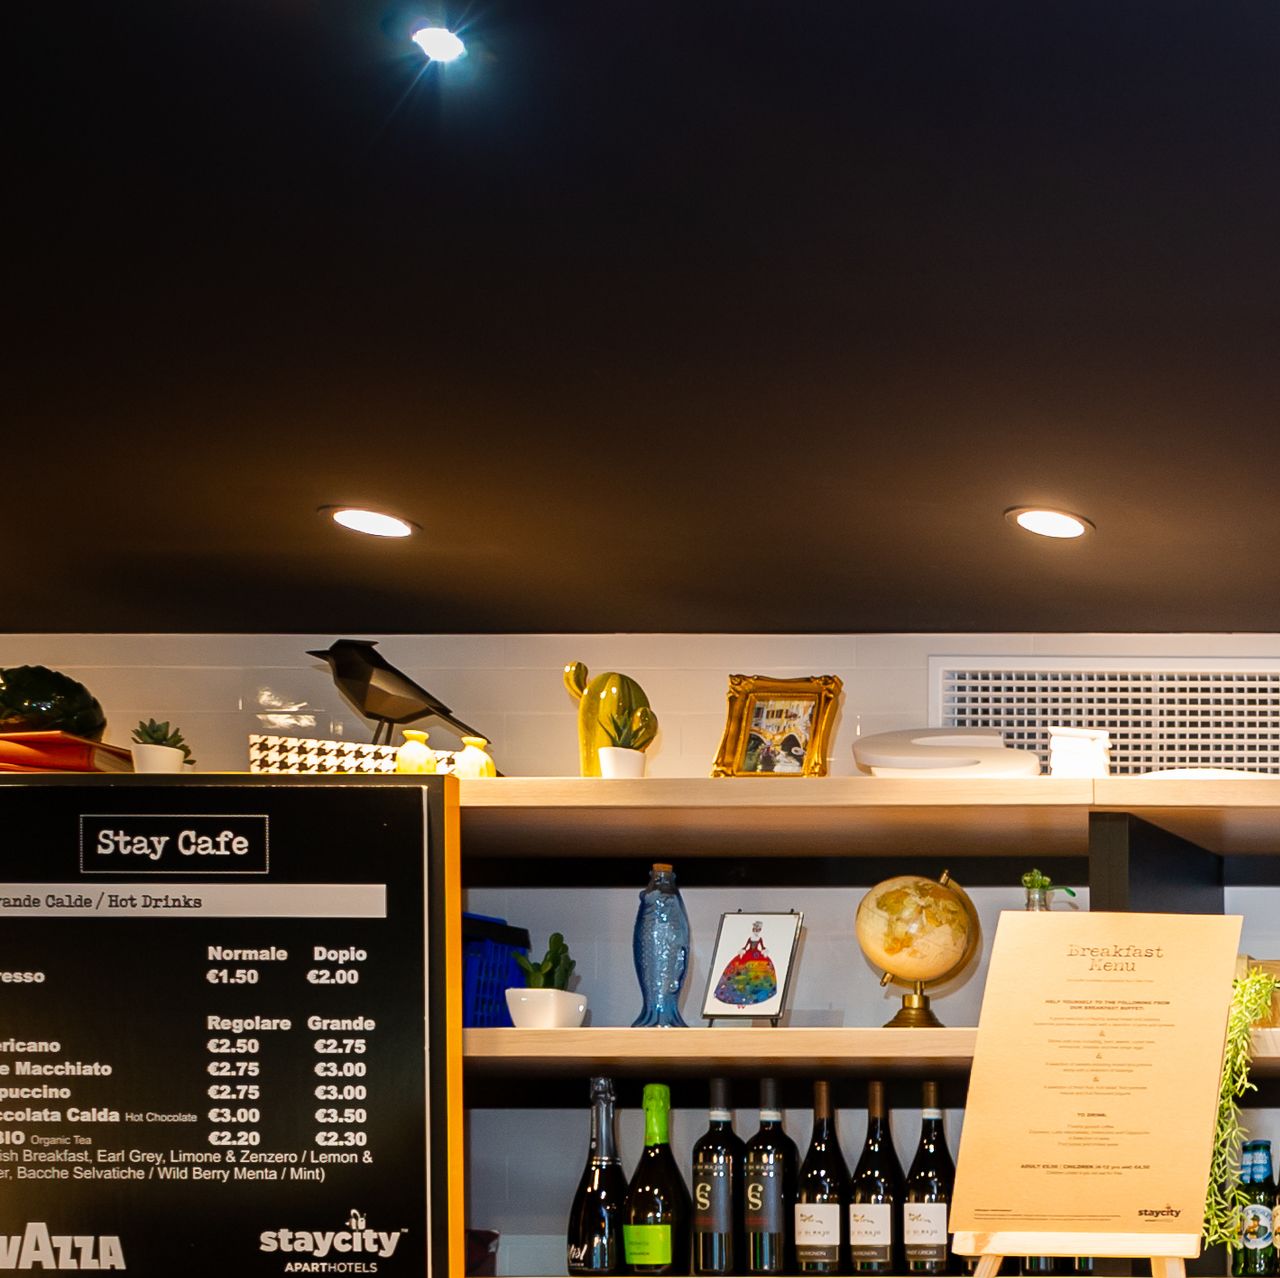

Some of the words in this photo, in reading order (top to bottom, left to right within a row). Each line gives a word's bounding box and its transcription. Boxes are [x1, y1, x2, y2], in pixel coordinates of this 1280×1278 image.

[97, 829, 170, 860] Stay
[177, 830, 248, 855] Cafe
[44, 894, 92, 908] Calde
[95, 891, 104, 910] /
[107, 894, 137, 908] Hot
[140, 894, 202, 908] Drinks
[207, 945, 287, 960] Normale
[313, 946, 367, 964] Dopio
[1067, 944, 1164, 958] Breakfast
[1089, 958, 1136, 971] Menu
[0, 971, 45, 982] esso
[206, 968, 258, 983] €1.50
[306, 969, 358, 984] €2.00
[207, 1015, 291, 1033] Regolare
[307, 1015, 375, 1030] Grande
[206, 1038, 259, 1053] €2.50
[313, 1038, 366, 1053] €2.75
[15, 1061, 112, 1075] Macchiato
[207, 1061, 259, 1076] €2.75
[313, 1061, 366, 1077] €3.00
[207, 1084, 259, 1099] €2.75
[314, 1084, 366, 1100] €3.00
[0, 1107, 61, 1121] colata
[66, 1107, 120, 1121] Calda
[125, 1112, 143, 1121] Hot
[145, 1111, 197, 1121] Chocolate
[207, 1107, 260, 1122] €3.00
[314, 1108, 366, 1123] €3.50
[30, 1134, 70, 1146] Organic
[73, 1135, 91, 1144] Tea
[207, 1130, 260, 1145] €2.20
[314, 1131, 367, 1146] €2.30
[22, 1148, 92, 1163] Breakfast,
[96, 1149, 124, 1162] Earl
[128, 1149, 165, 1165] Grey,
[170, 1149, 221, 1162] Limone
[225, 1149, 236, 1162] &
[239, 1149, 297, 1163] Zenzero
[300, 1149, 307, 1162] /
[310, 1150, 358, 1163] Lemon
[362, 1149, 373, 1163] &
[16, 1165, 69, 1179] Bacche
[72, 1165, 145, 1179] Selvatiche
[148, 1166, 154, 1179] /
[157, 1166, 188, 1179] Wild
[192, 1166, 230, 1182] Berry
[233, 1166, 277, 1179] Menta
[280, 1166, 286, 1179] /
[290, 1166, 325, 1182] Mint)
[1138, 1209, 1181, 1217] staycity
[259, 1225, 400, 1257] staycity
[284, 1262, 377, 1272] APARTHOTELS
